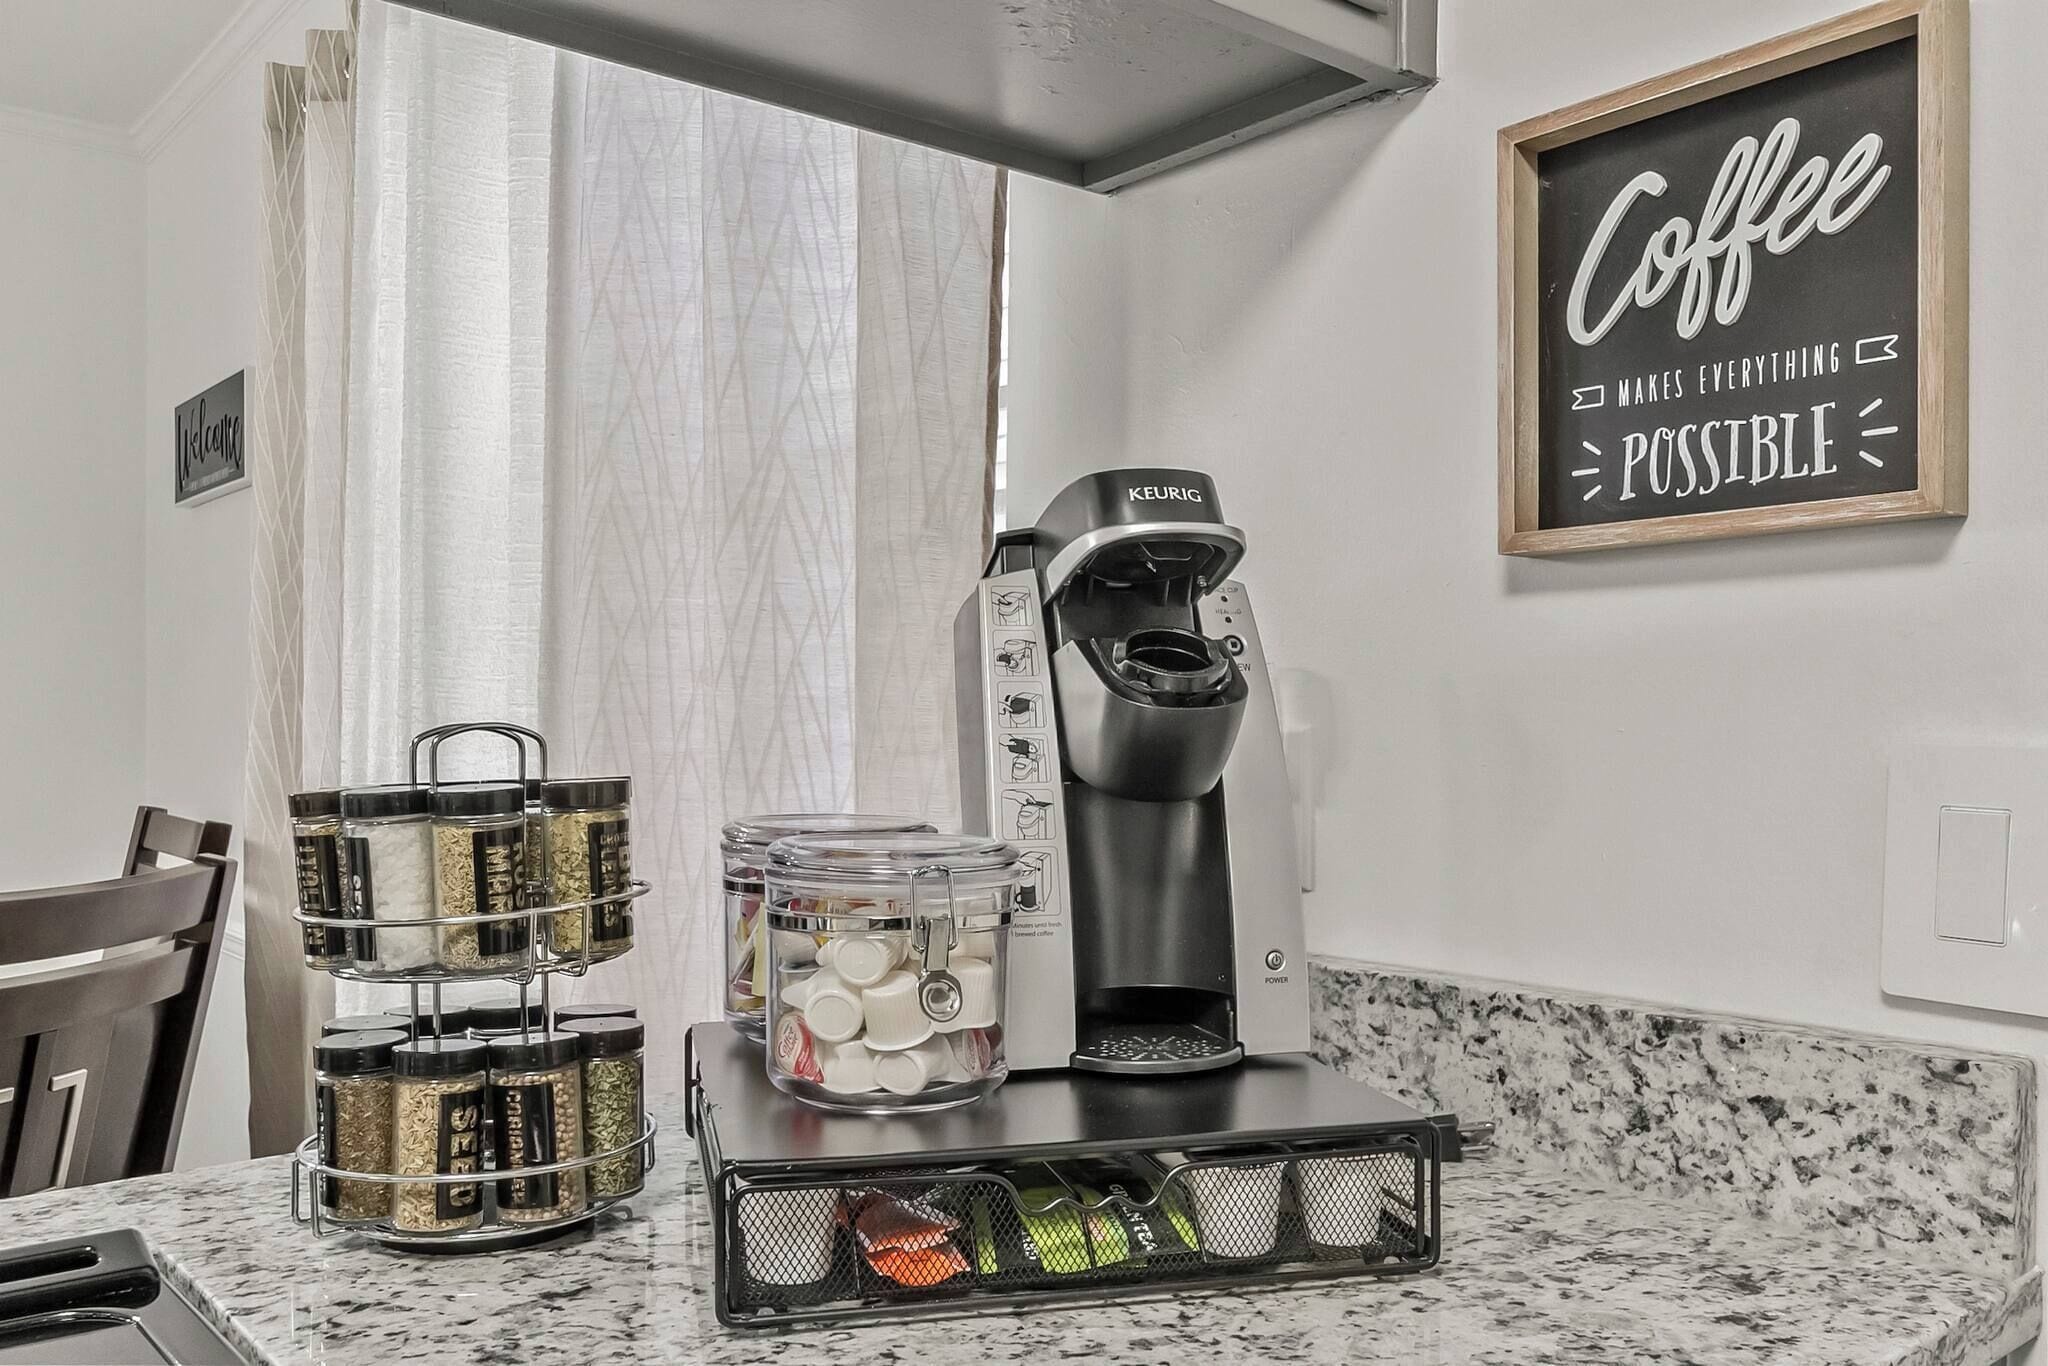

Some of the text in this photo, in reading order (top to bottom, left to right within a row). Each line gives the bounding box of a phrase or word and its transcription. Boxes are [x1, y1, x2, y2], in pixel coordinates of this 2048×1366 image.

[1566, 117, 1892, 345] Coffee
[1618, 343, 1839, 407] MAKES EVERYTHING
[177, 398, 243, 494] Welcome
[1128, 486, 1202, 503] KEURIG
[1619, 401, 1838, 501] POSSIBLE
[1238, 663, 1251, 672] EW
[299, 846, 324, 945] ITALIN
[1265, 976, 1289, 984] POWER
[450, 1105, 478, 1207] SEED
[505, 1089, 527, 1205] CORIANER
